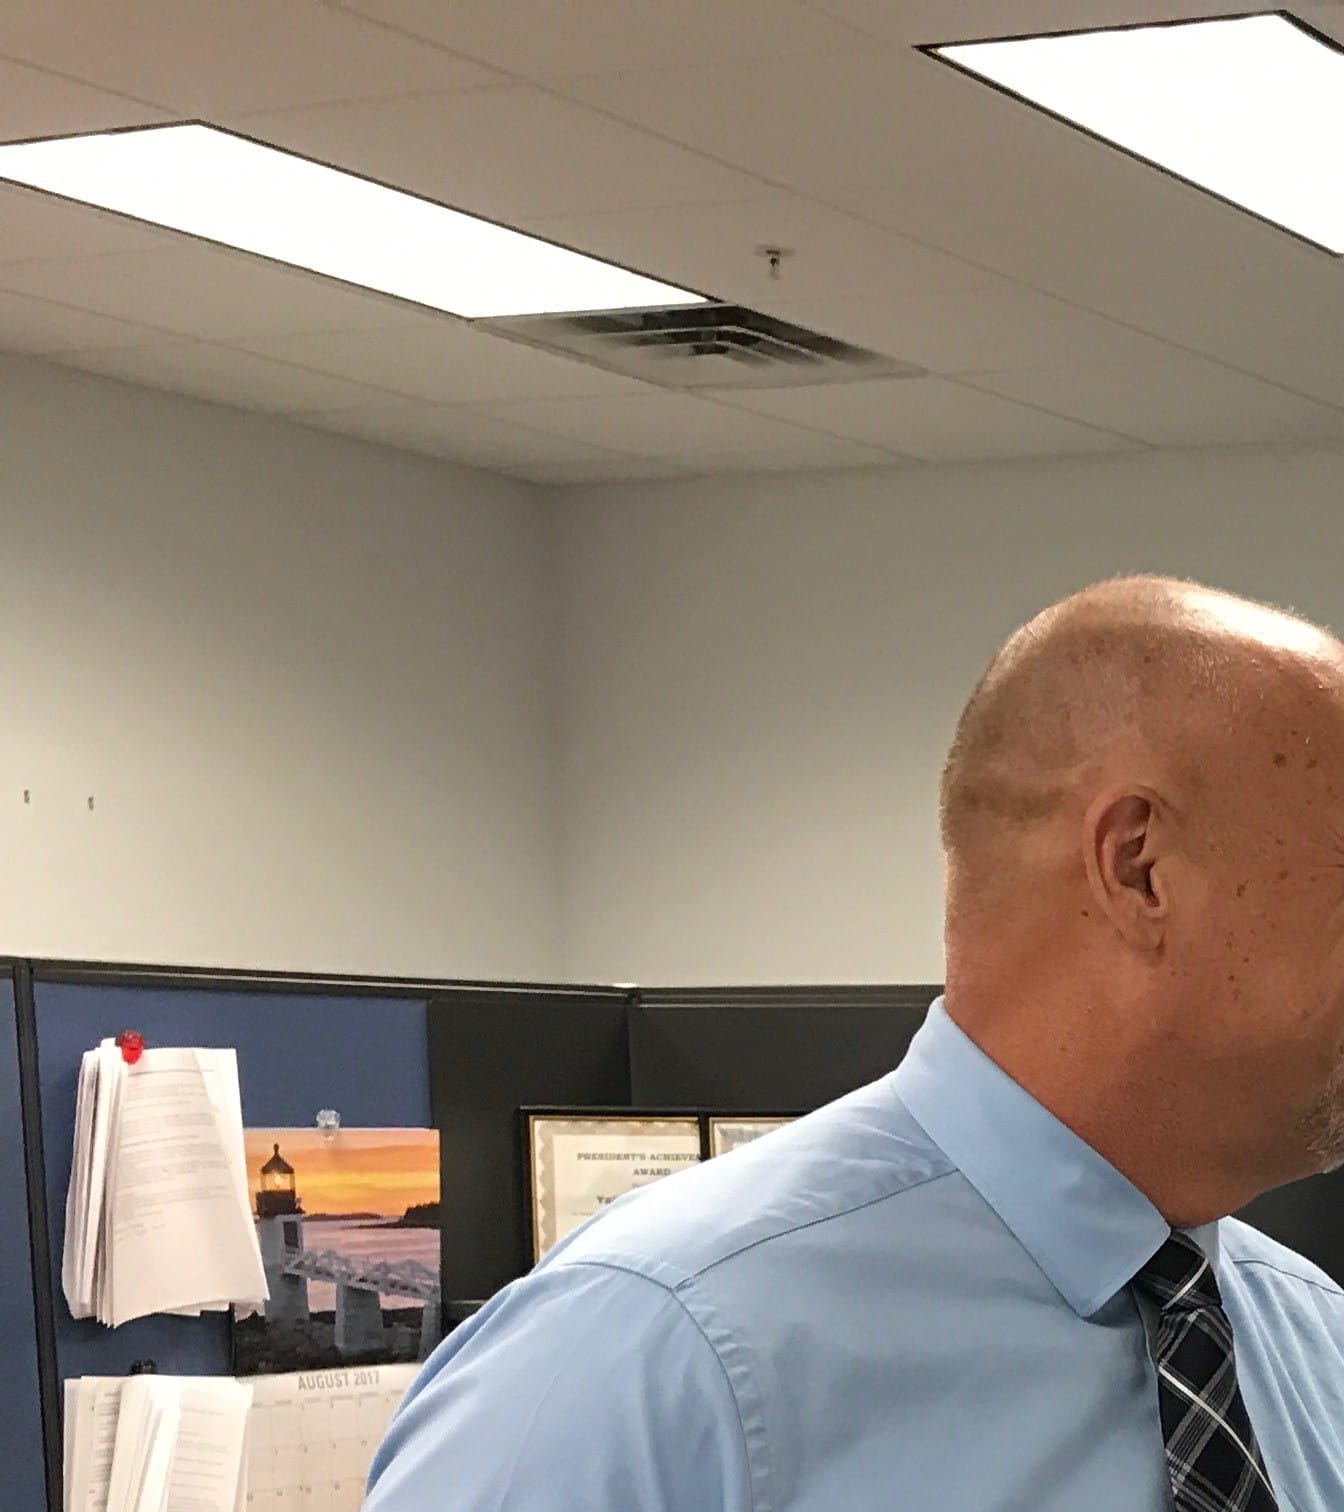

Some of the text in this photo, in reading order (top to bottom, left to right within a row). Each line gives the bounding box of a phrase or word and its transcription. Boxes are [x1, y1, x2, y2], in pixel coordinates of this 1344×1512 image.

[577, 1152, 646, 1161] PRESIDENT'S
[632, 1168, 672, 1176] AWARD
[298, 1370, 380, 1391] AUGUST 2017
